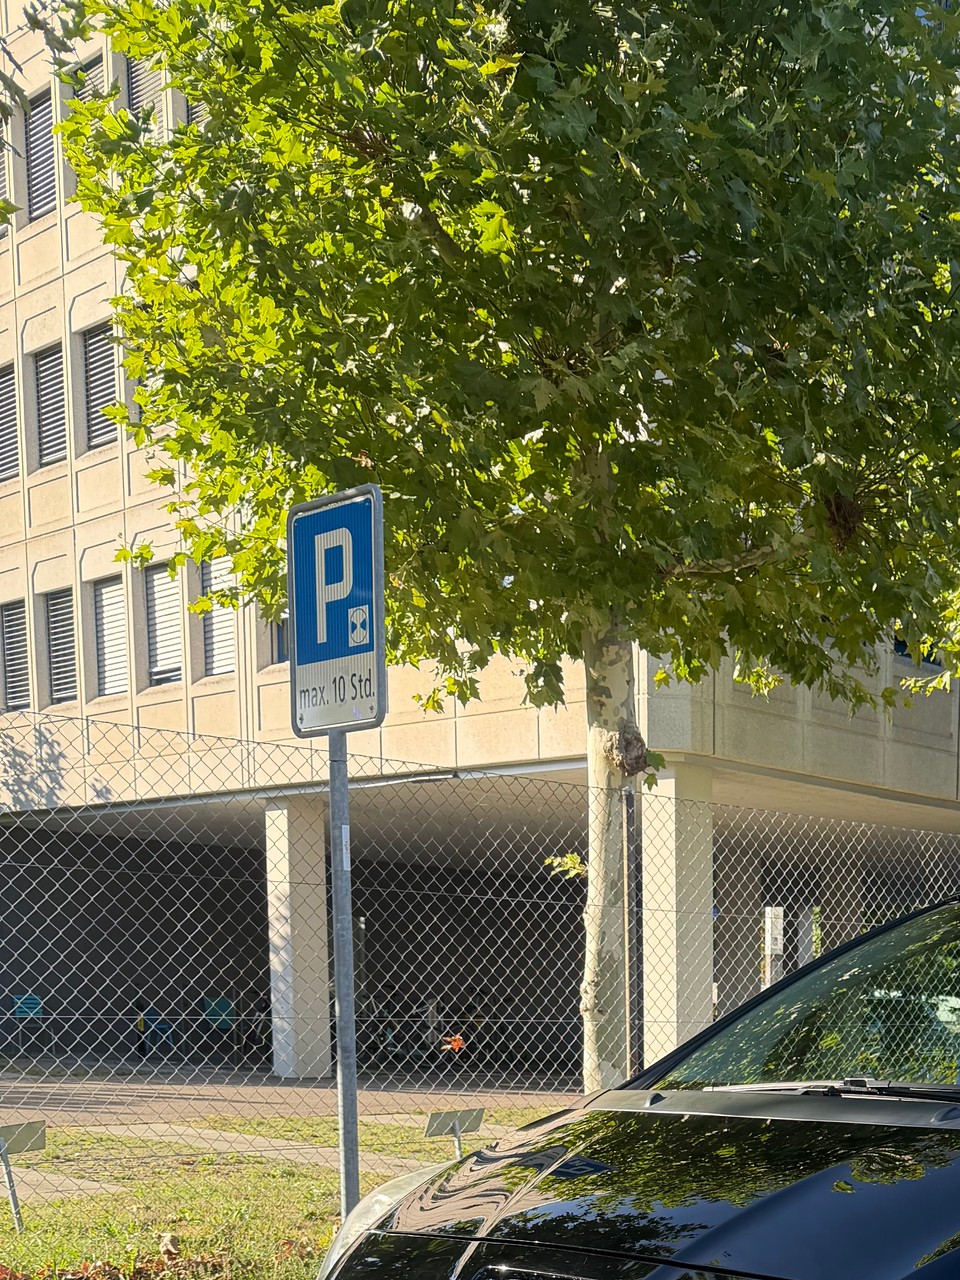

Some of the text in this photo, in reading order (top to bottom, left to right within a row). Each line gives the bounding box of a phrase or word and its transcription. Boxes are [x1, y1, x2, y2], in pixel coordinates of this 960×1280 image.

[314, 527, 353, 644] P
[299, 668, 375, 709] max. 10 Std.
